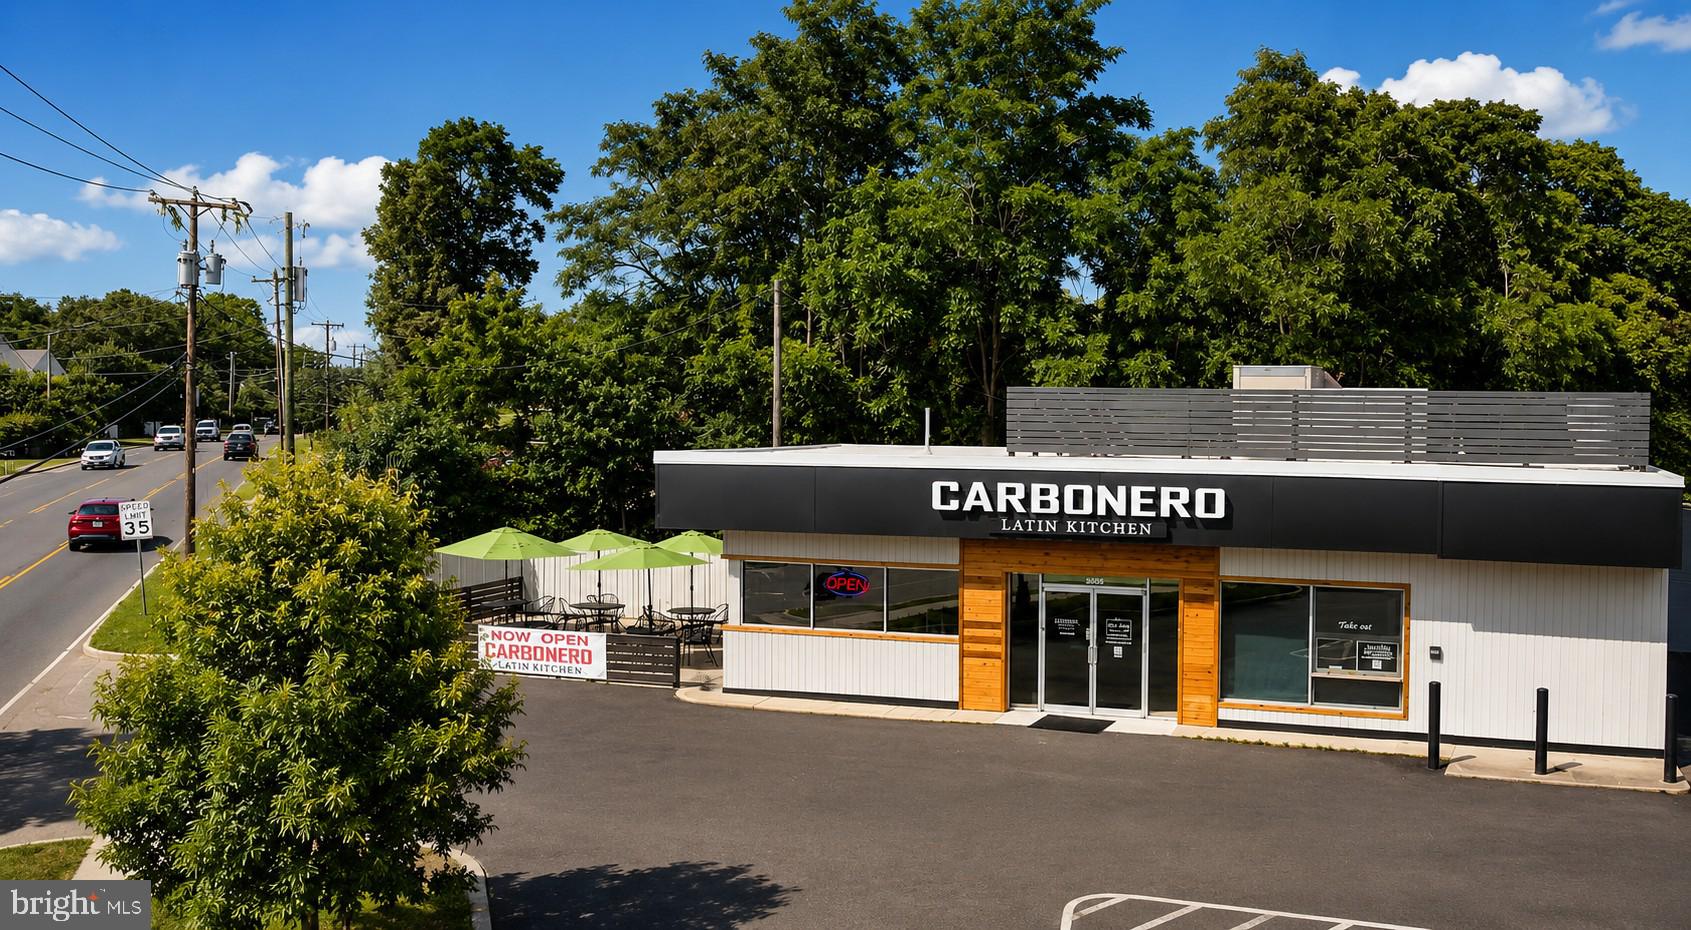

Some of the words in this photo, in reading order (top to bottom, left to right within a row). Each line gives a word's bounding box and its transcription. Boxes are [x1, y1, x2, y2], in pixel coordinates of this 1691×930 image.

[931, 480, 1226, 519] CARBONERO
[124, 520, 150, 535] 35
[1001, 518, 1058, 532] LATIN
[1066, 520, 1153, 535] KITCHEN
[825, 576, 867, 593] OPEN
[1338, 620, 1358, 630] Take
[491, 630, 531, 642] NOW
[541, 633, 588, 646] OPEN
[485, 642, 592, 665] CARBONERO
[498, 660, 530, 671] LATIN
[533, 662, 582, 674] KITCHEN
